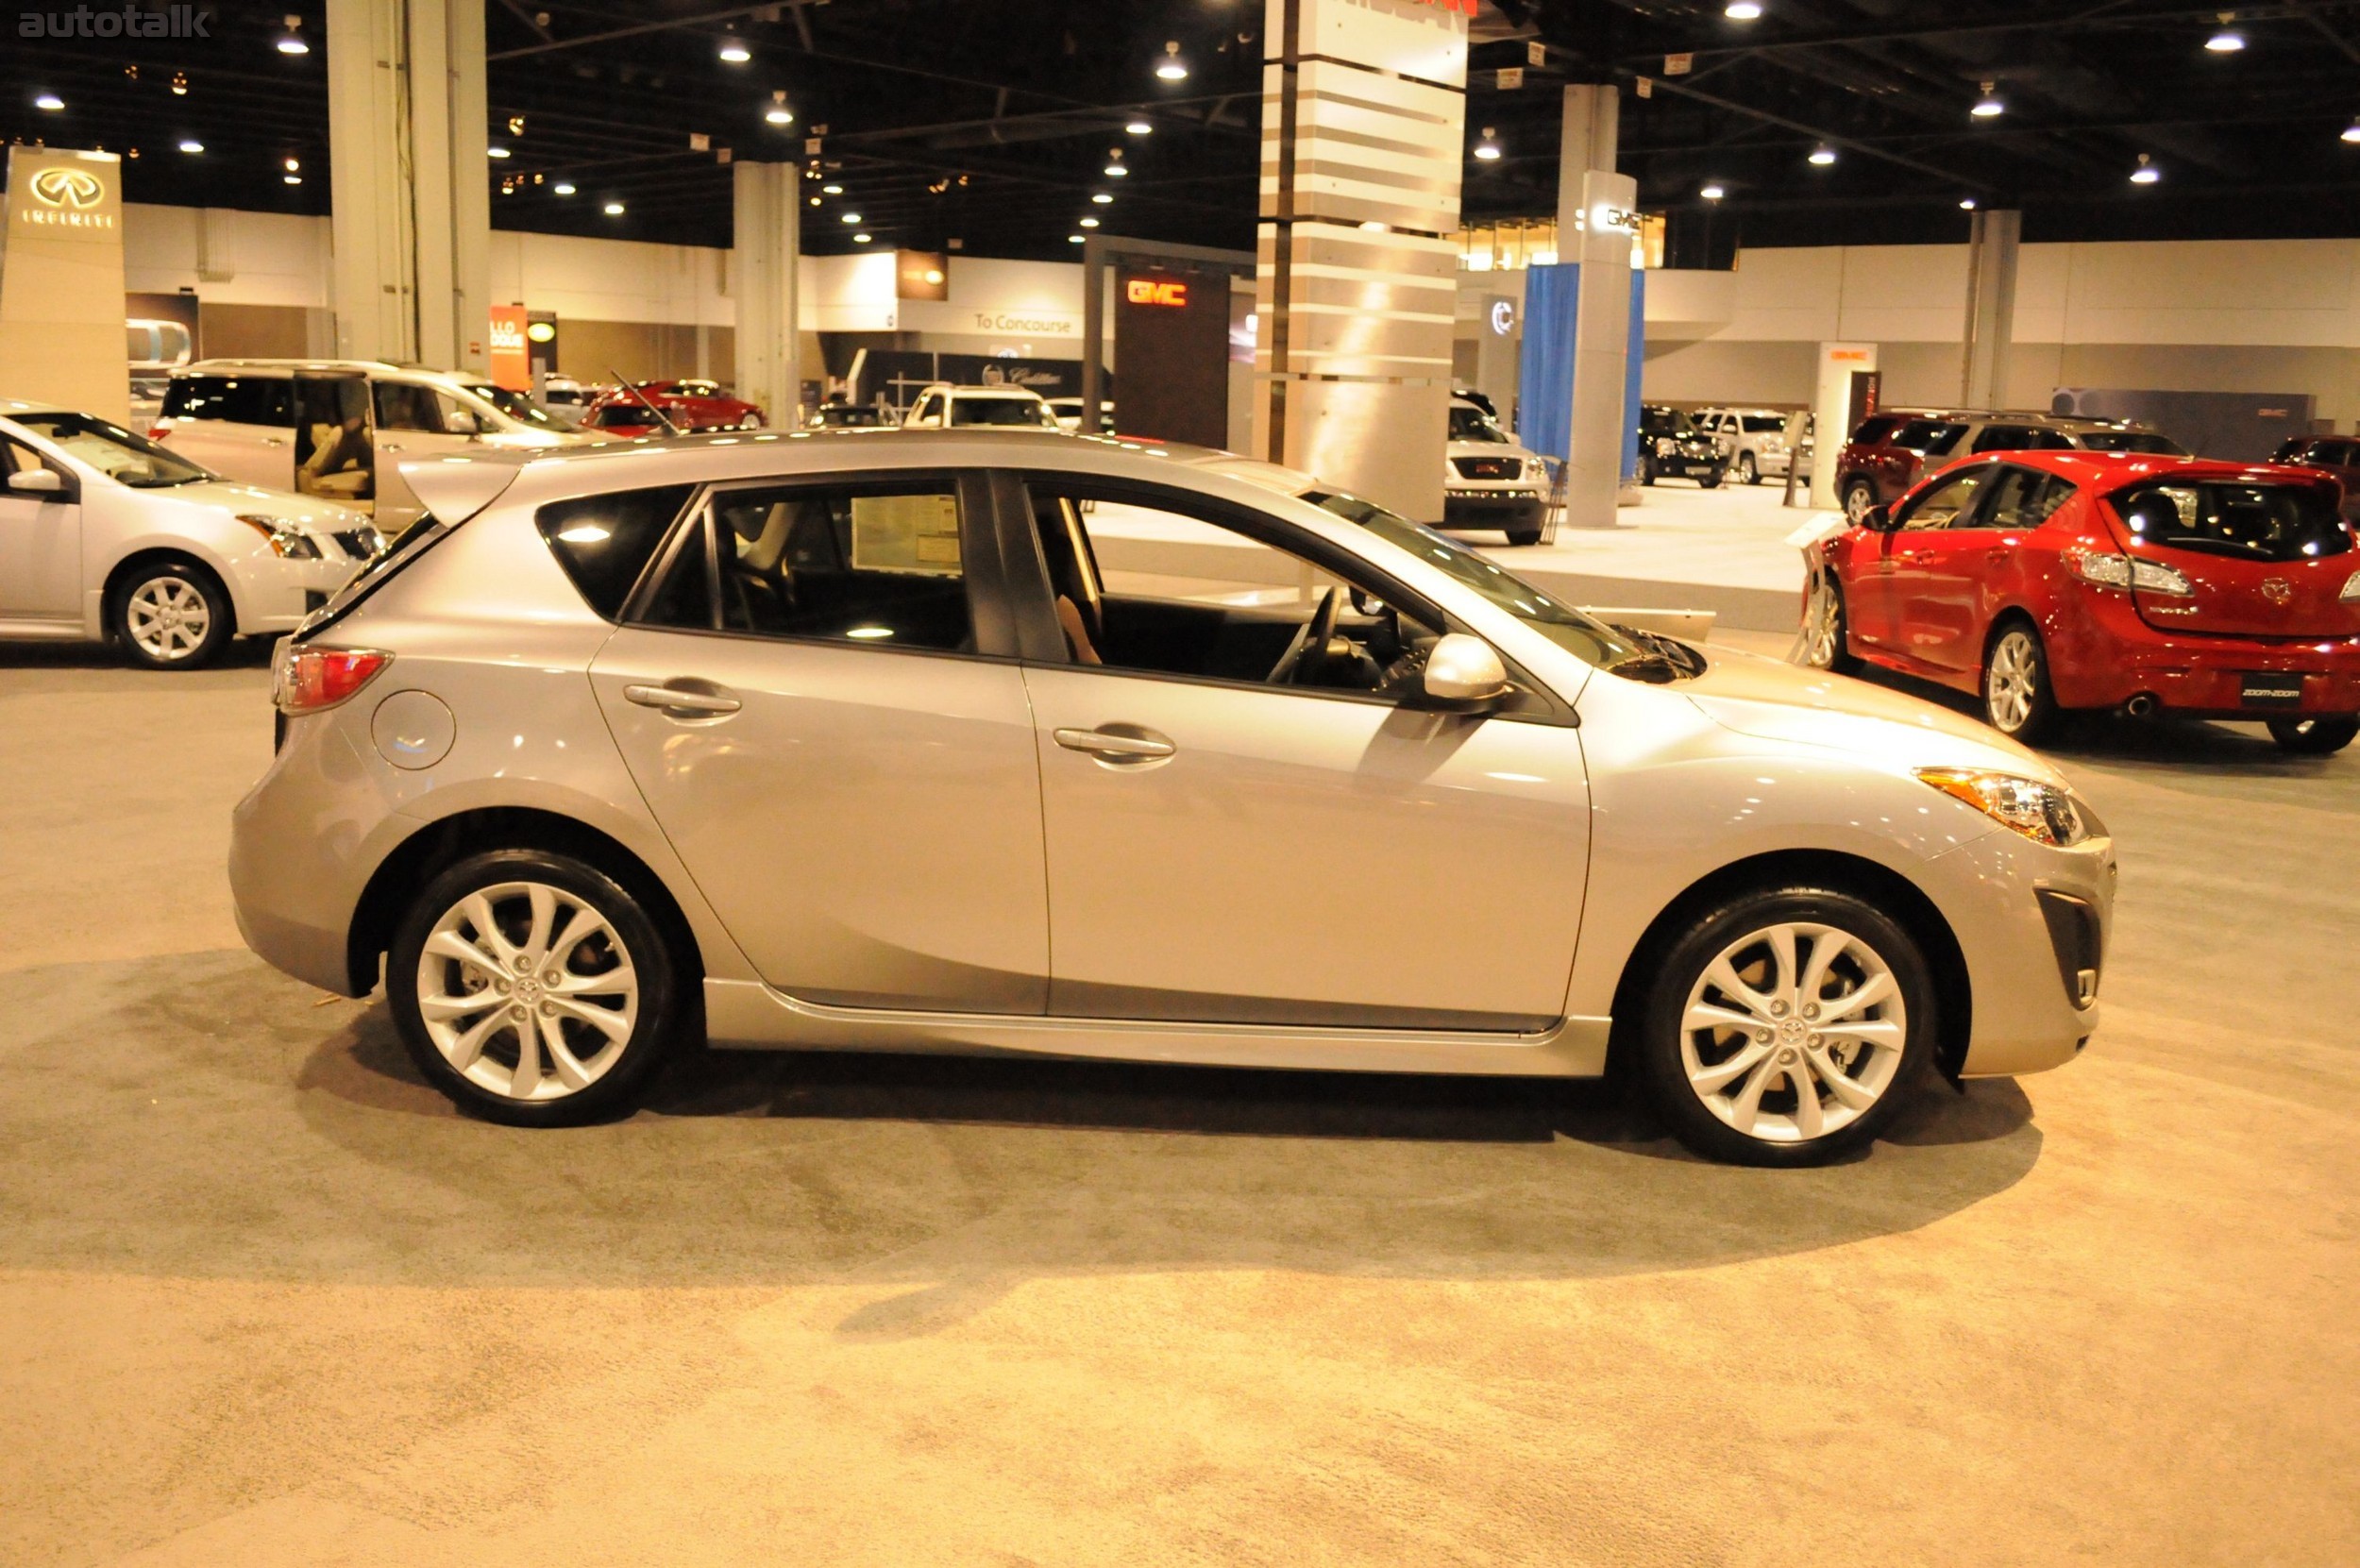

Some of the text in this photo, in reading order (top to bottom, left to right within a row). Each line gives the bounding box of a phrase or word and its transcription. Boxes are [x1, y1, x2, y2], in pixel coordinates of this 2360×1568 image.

[1127, 279, 1187, 306] GMC
[974, 313, 1071, 333] To Concourse
